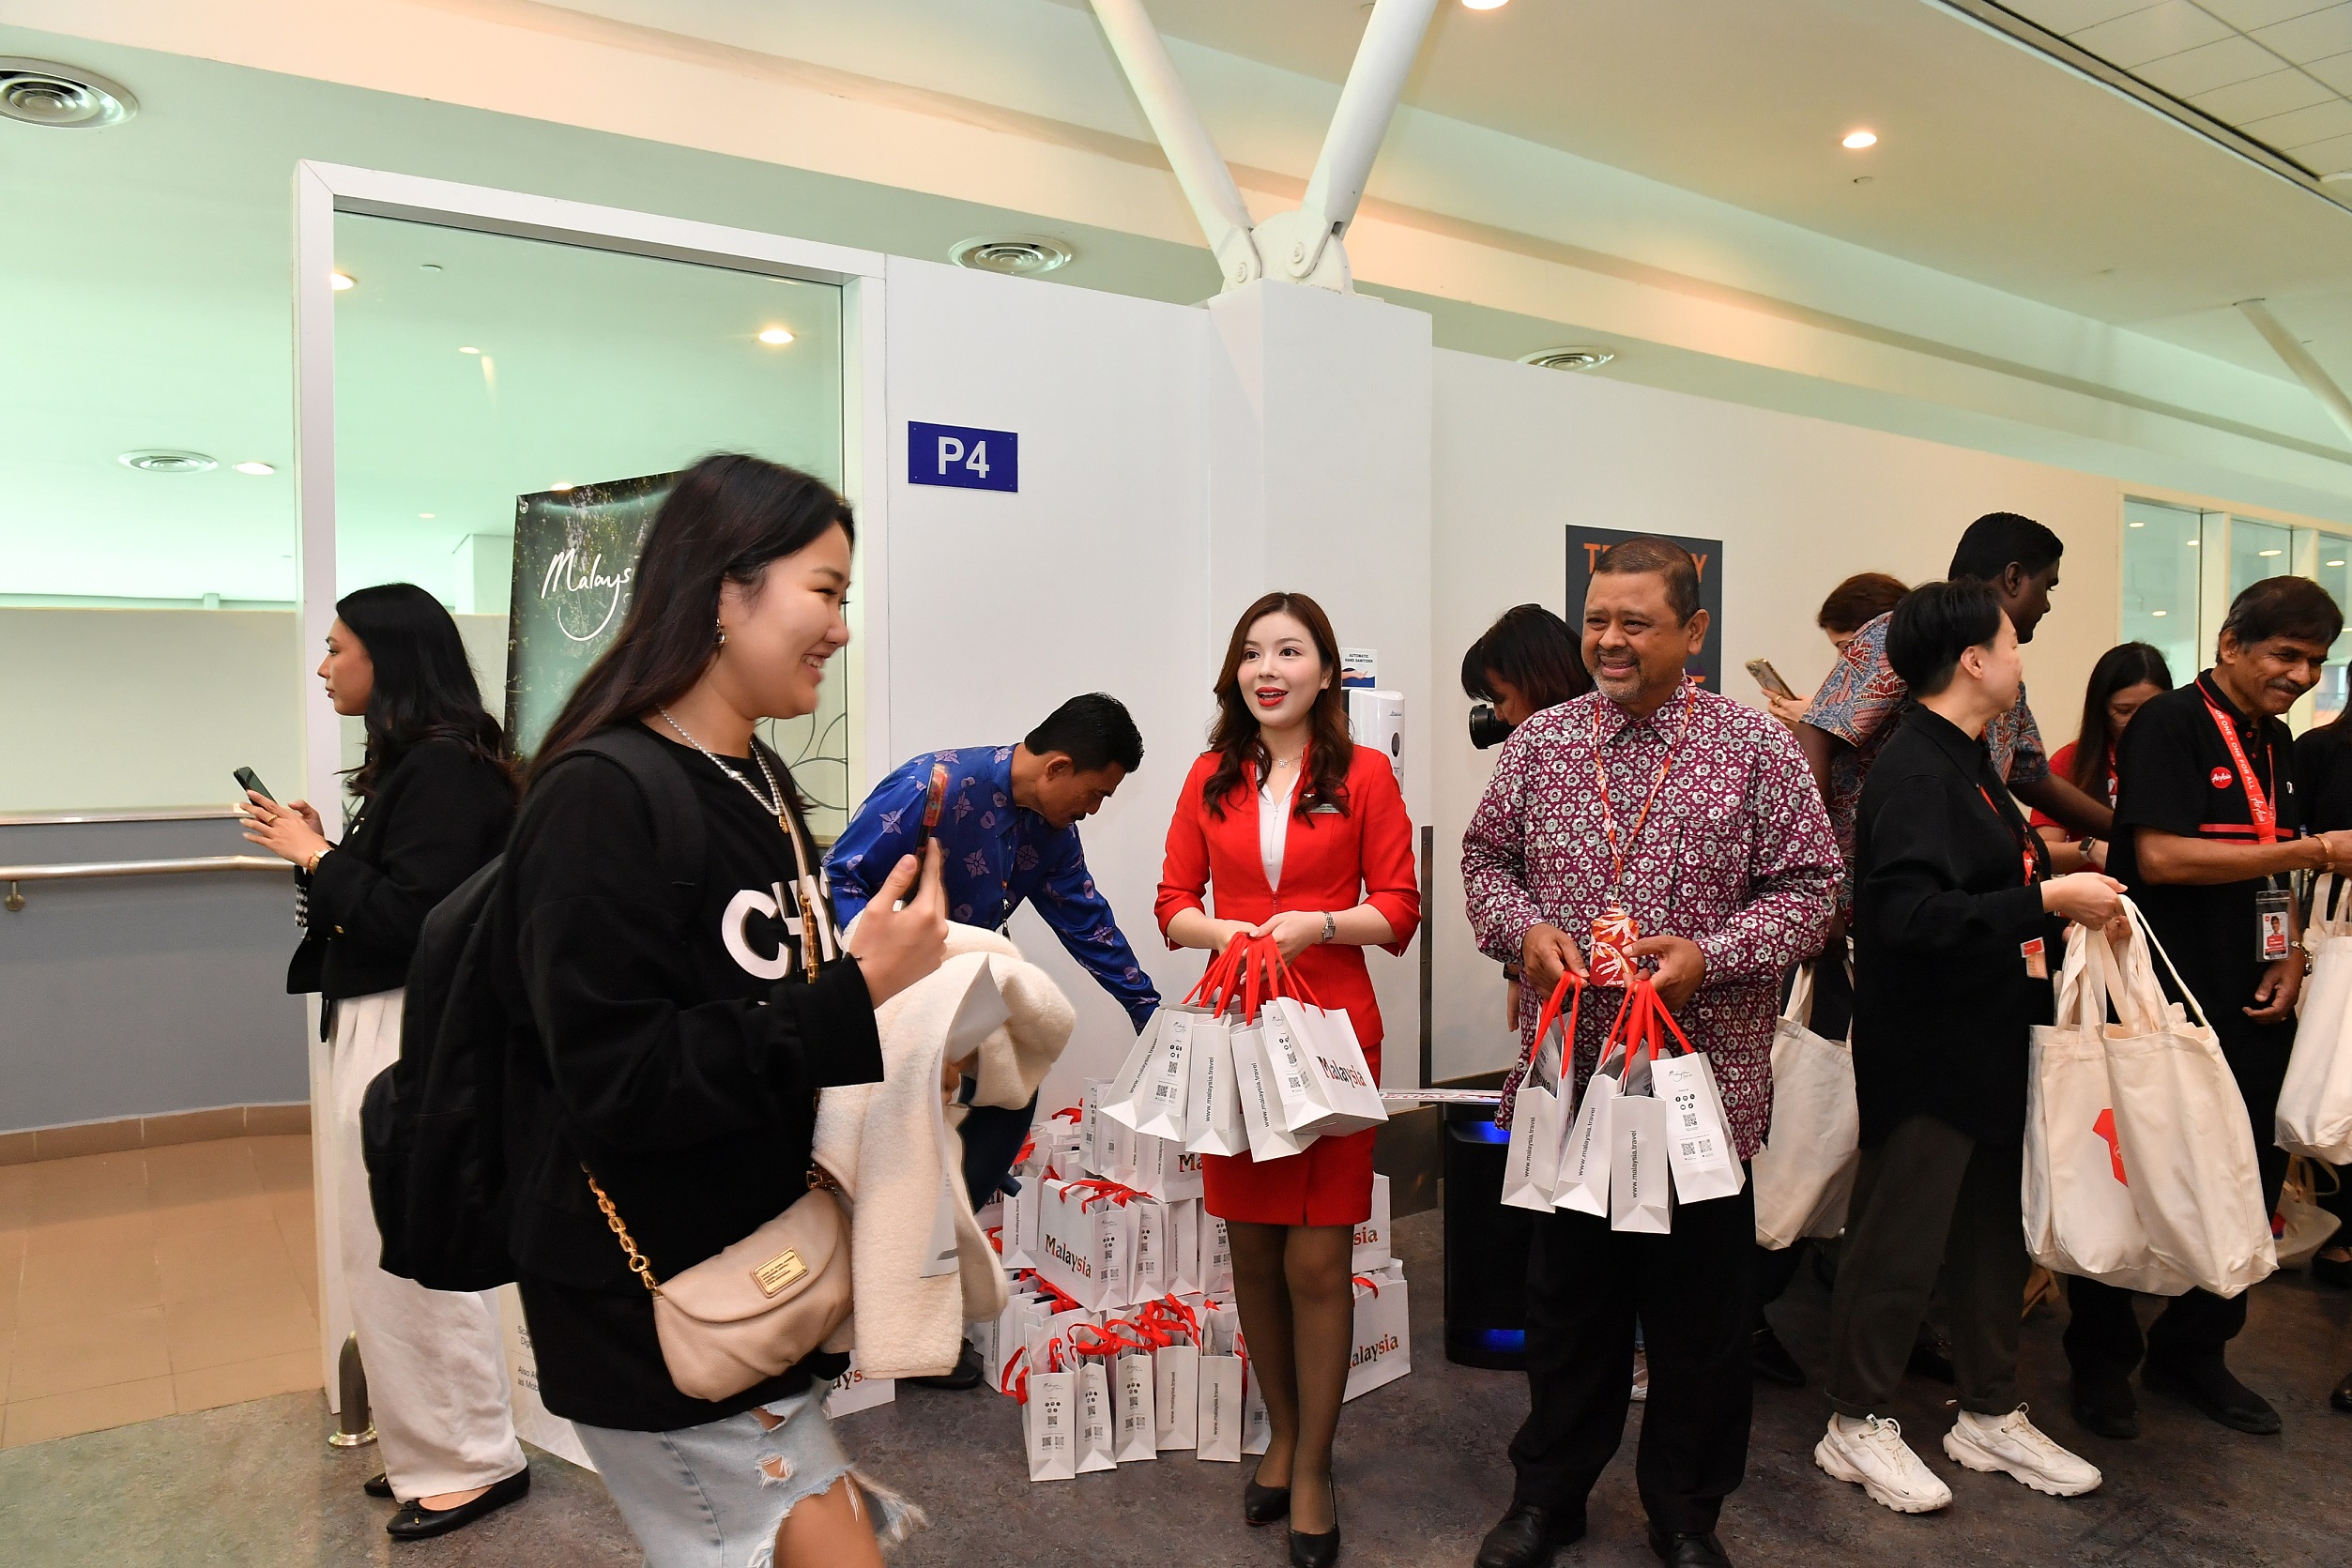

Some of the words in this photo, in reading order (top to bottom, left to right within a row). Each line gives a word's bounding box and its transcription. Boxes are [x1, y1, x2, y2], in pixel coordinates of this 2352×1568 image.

[939, 435, 990, 479] P4
[541, 548, 632, 642] Malays
[2221, 720, 2233, 736] ONE
[2231, 742, 2242, 758] ONE
[2238, 759, 2250, 774] FOR
[2246, 775, 2255, 790] ALL
[2251, 798, 2268, 823] AirAsia
[722, 869, 840, 980] CHI
[1205, 1057, 1214, 1122] www.malaysia.travel
[1250, 1061, 1270, 1128] www.malaysia.travel
[1316, 1056, 1367, 1088] Malaysia
[1524, 1117, 1536, 1177] www.malaysia.travel
[1578, 1107, 1596, 1177] www.malaysia.travel
[1046, 1233, 1092, 1279] Malaysia
[1351, 1333, 1399, 1368] alaysia
